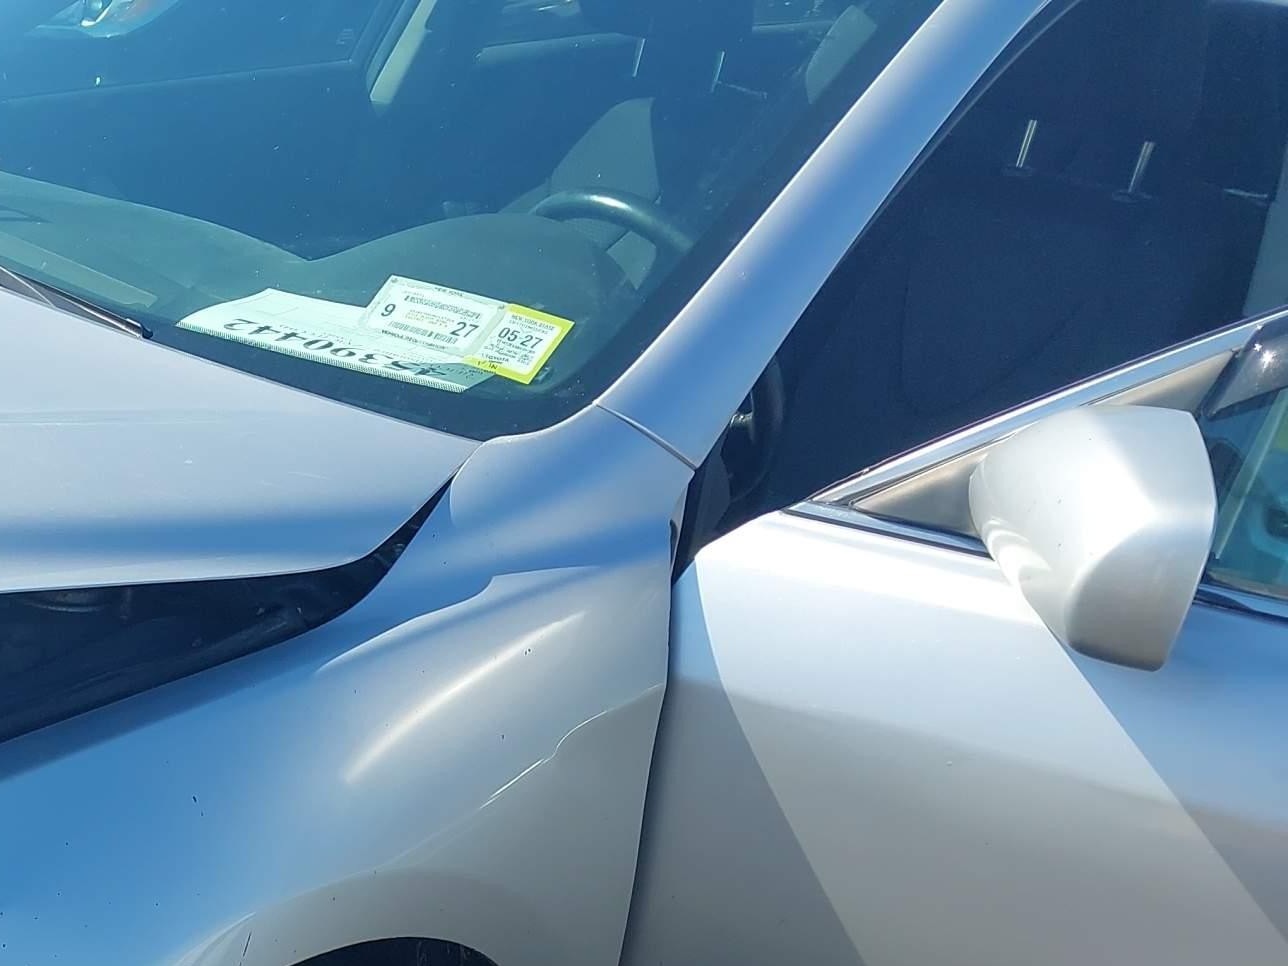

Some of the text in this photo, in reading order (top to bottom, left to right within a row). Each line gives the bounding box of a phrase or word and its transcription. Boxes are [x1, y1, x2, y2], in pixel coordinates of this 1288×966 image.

[381, 303, 396, 317] 9
[449, 321, 480, 338] 27
[498, 327, 543, 348] 05-27
[224, 318, 447, 376] 45390442
